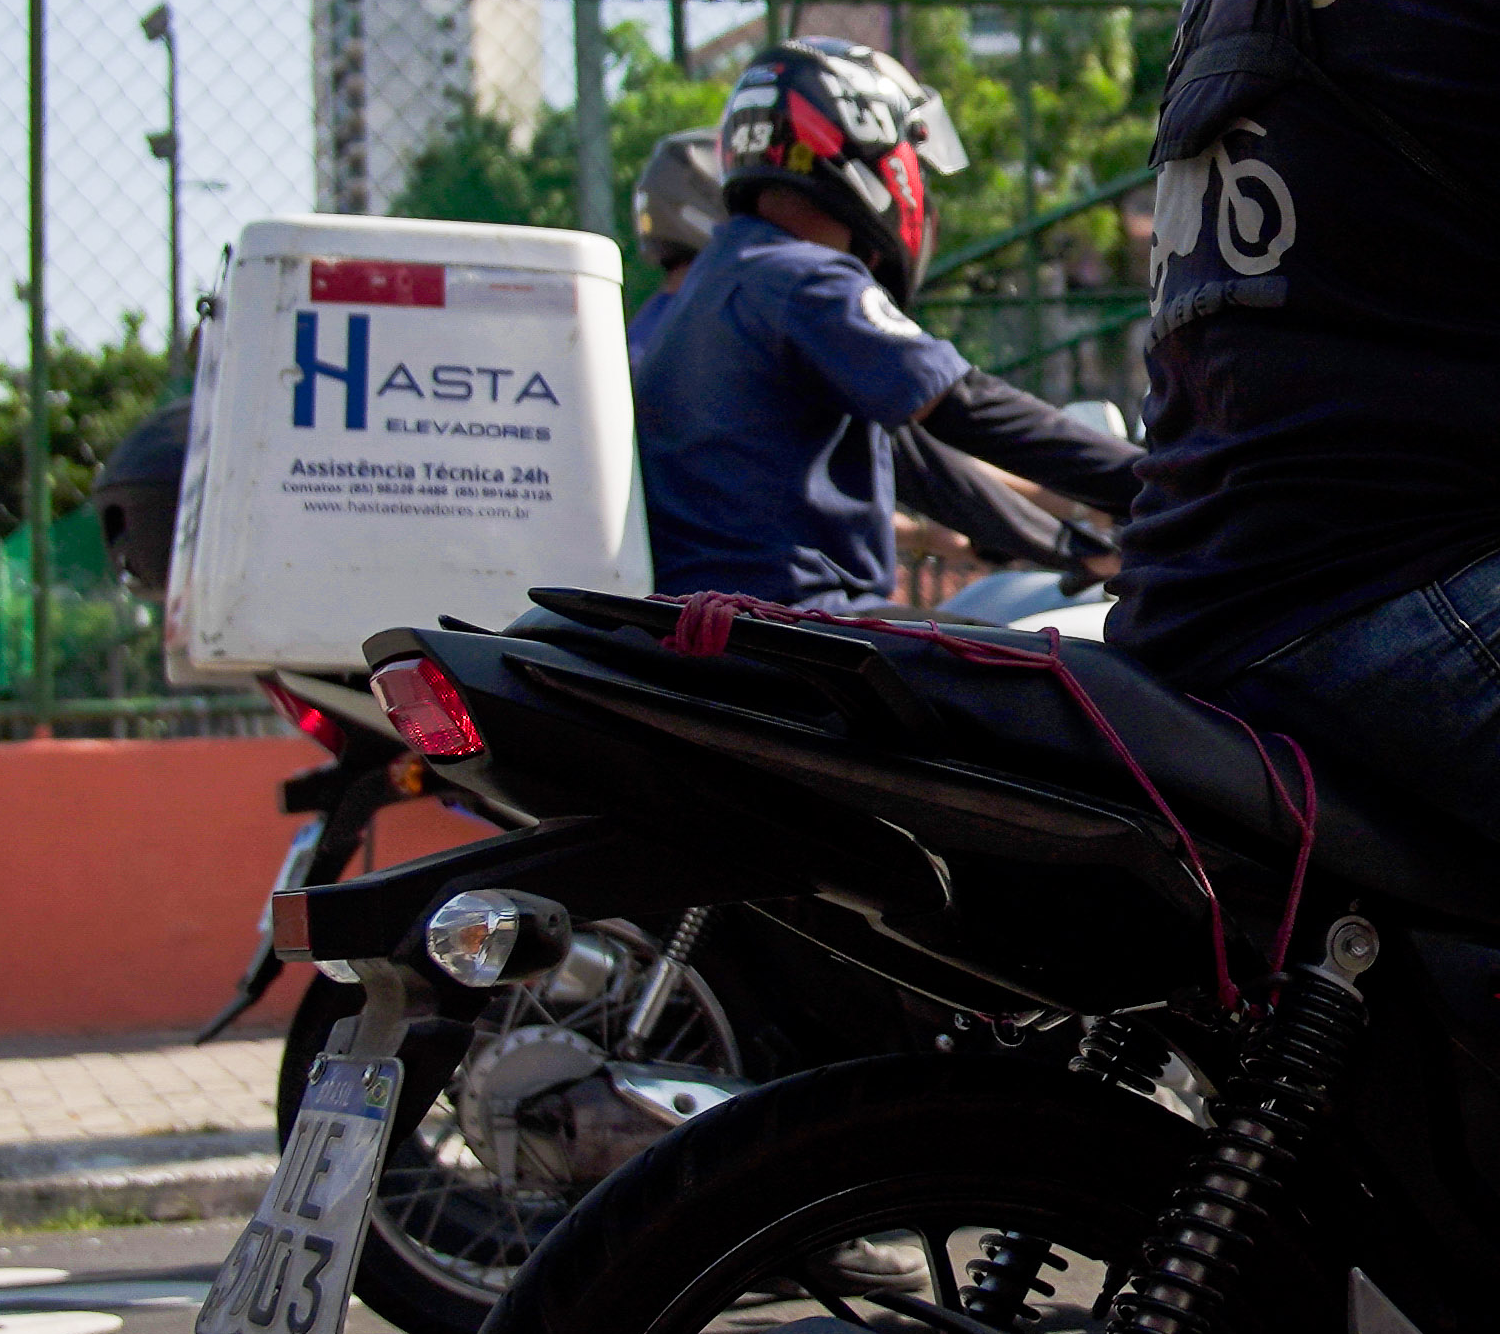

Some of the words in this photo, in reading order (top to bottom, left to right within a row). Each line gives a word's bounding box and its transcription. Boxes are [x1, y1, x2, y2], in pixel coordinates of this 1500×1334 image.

[293, 311, 561, 431] HASTA
[386, 418, 552, 442] ELEVADORES
[291, 457, 416, 480] Assistência
[422, 461, 505, 483] Técnica
[511, 466, 550, 485] 24h
